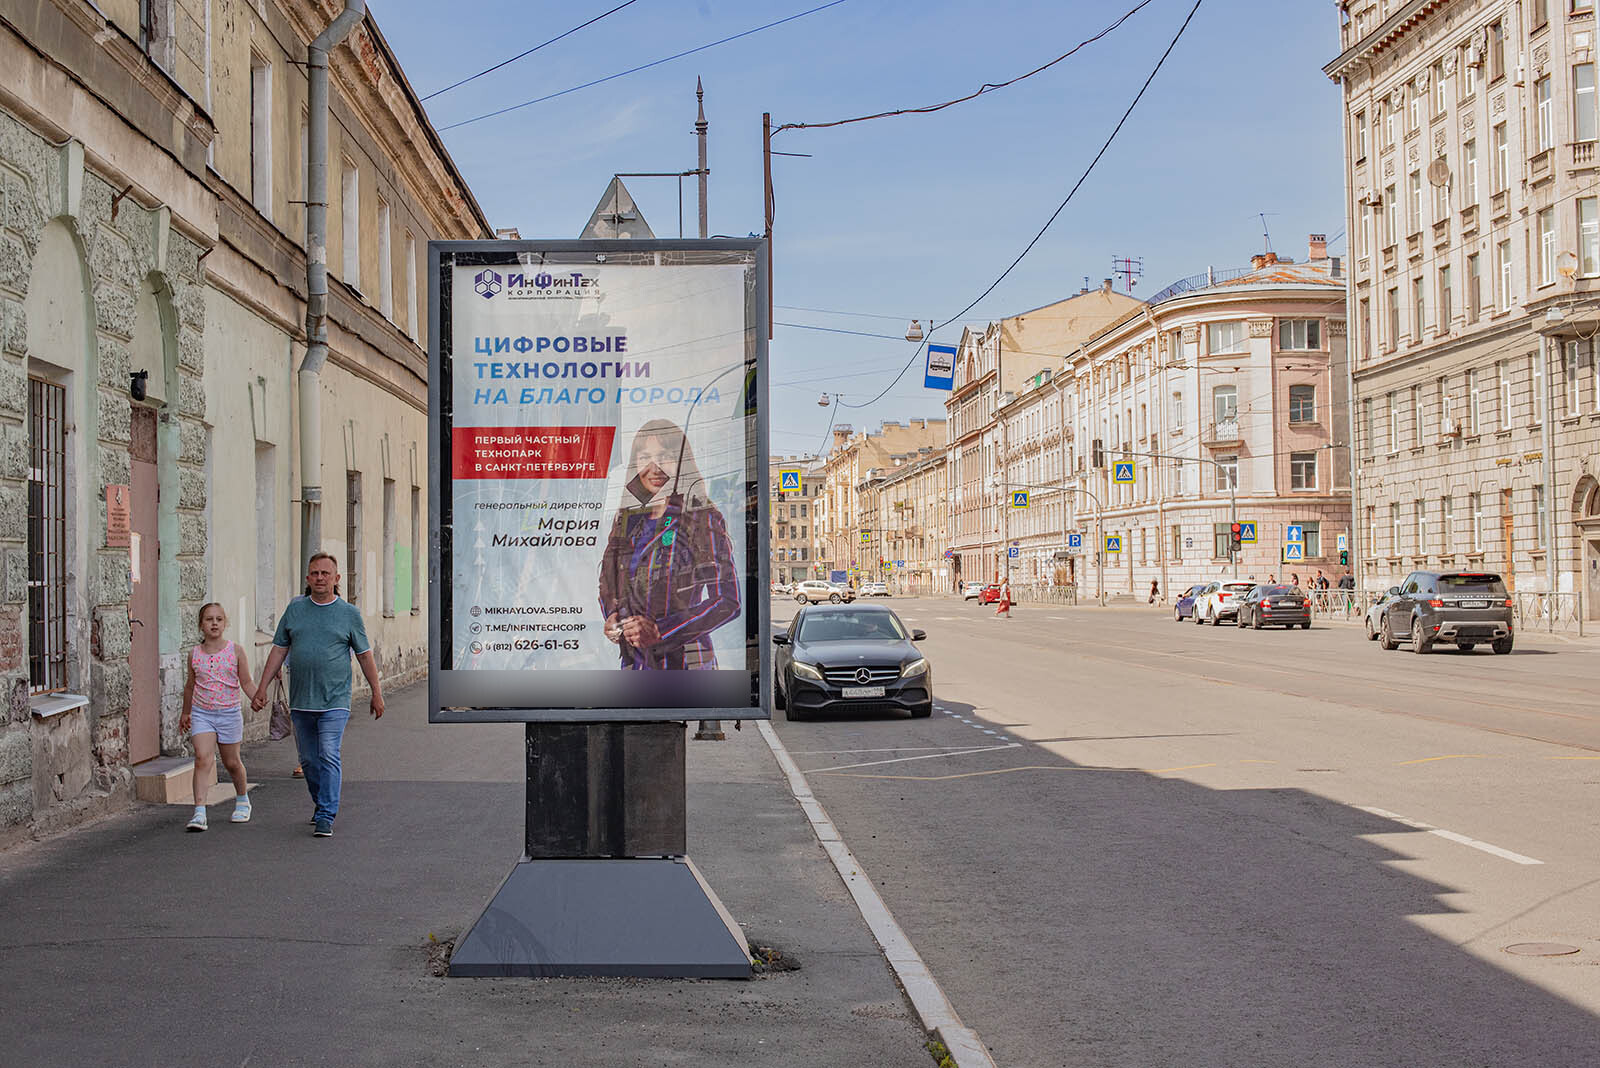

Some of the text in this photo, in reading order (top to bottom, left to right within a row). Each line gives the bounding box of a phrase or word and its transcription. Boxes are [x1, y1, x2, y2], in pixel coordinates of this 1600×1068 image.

[474, 336, 628, 356] ЦИФРОВЫЕ
[473, 362, 650, 379] ТЕХНОЛОГИИ
[473, 387, 721, 406] НА БЛАГО ГОРОДА
[474, 434, 581, 445] ПЕРВЫЙ ЧАСТНЫЙ
[474, 449, 542, 458] ТЕХНОПАРК
[475, 463, 596, 472] В САНКТ-ПЕТЕРБУРГЕ
[474, 501, 603, 511] генеральный директор
[538, 517, 600, 534] Мария
[491, 533, 598, 547] Михайлова
[485, 623, 586, 632] T.ME/INFINTECHCORP
[493, 642, 512, 651] (812)
[514, 639, 580, 650] 626-61-63
